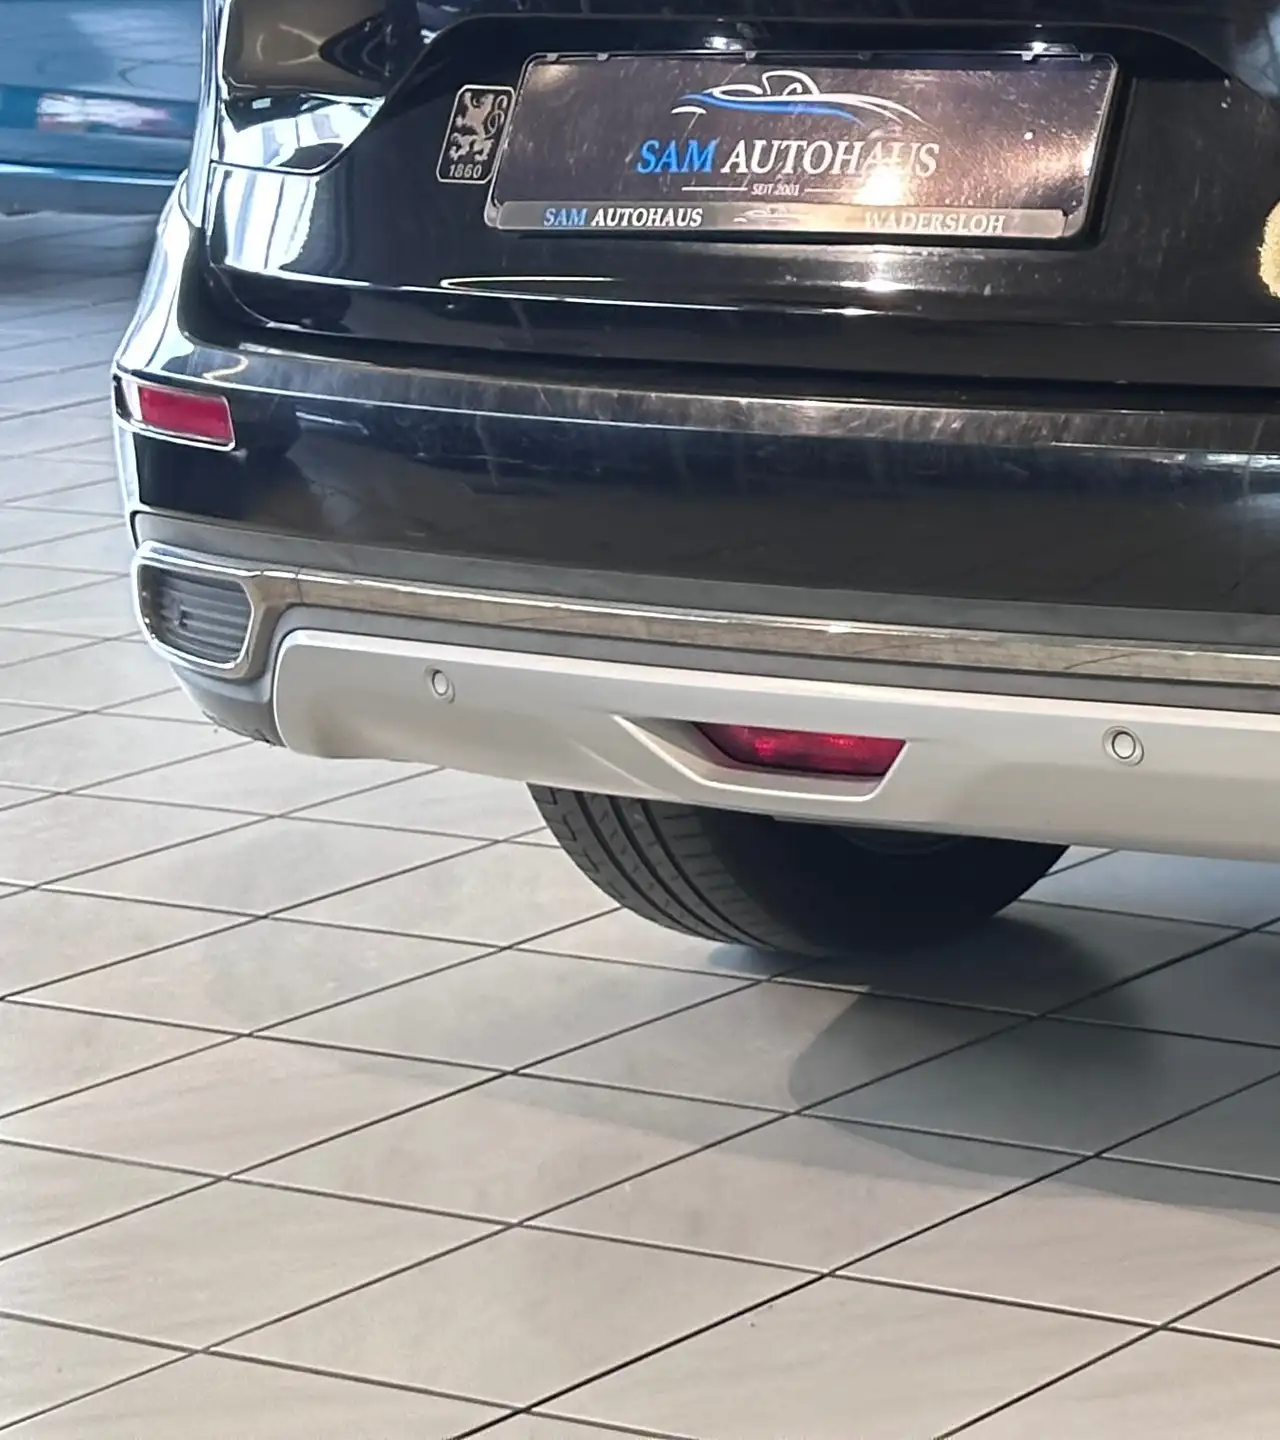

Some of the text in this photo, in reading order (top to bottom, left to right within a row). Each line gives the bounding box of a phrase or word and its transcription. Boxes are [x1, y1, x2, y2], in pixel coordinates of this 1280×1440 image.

[636, 138, 940, 178] SAM AUTOHAUS
[448, 163, 483, 179] 1860
[543, 207, 704, 228] SAM AUTOHAUS
[864, 211, 1007, 235] WADERSLOH
